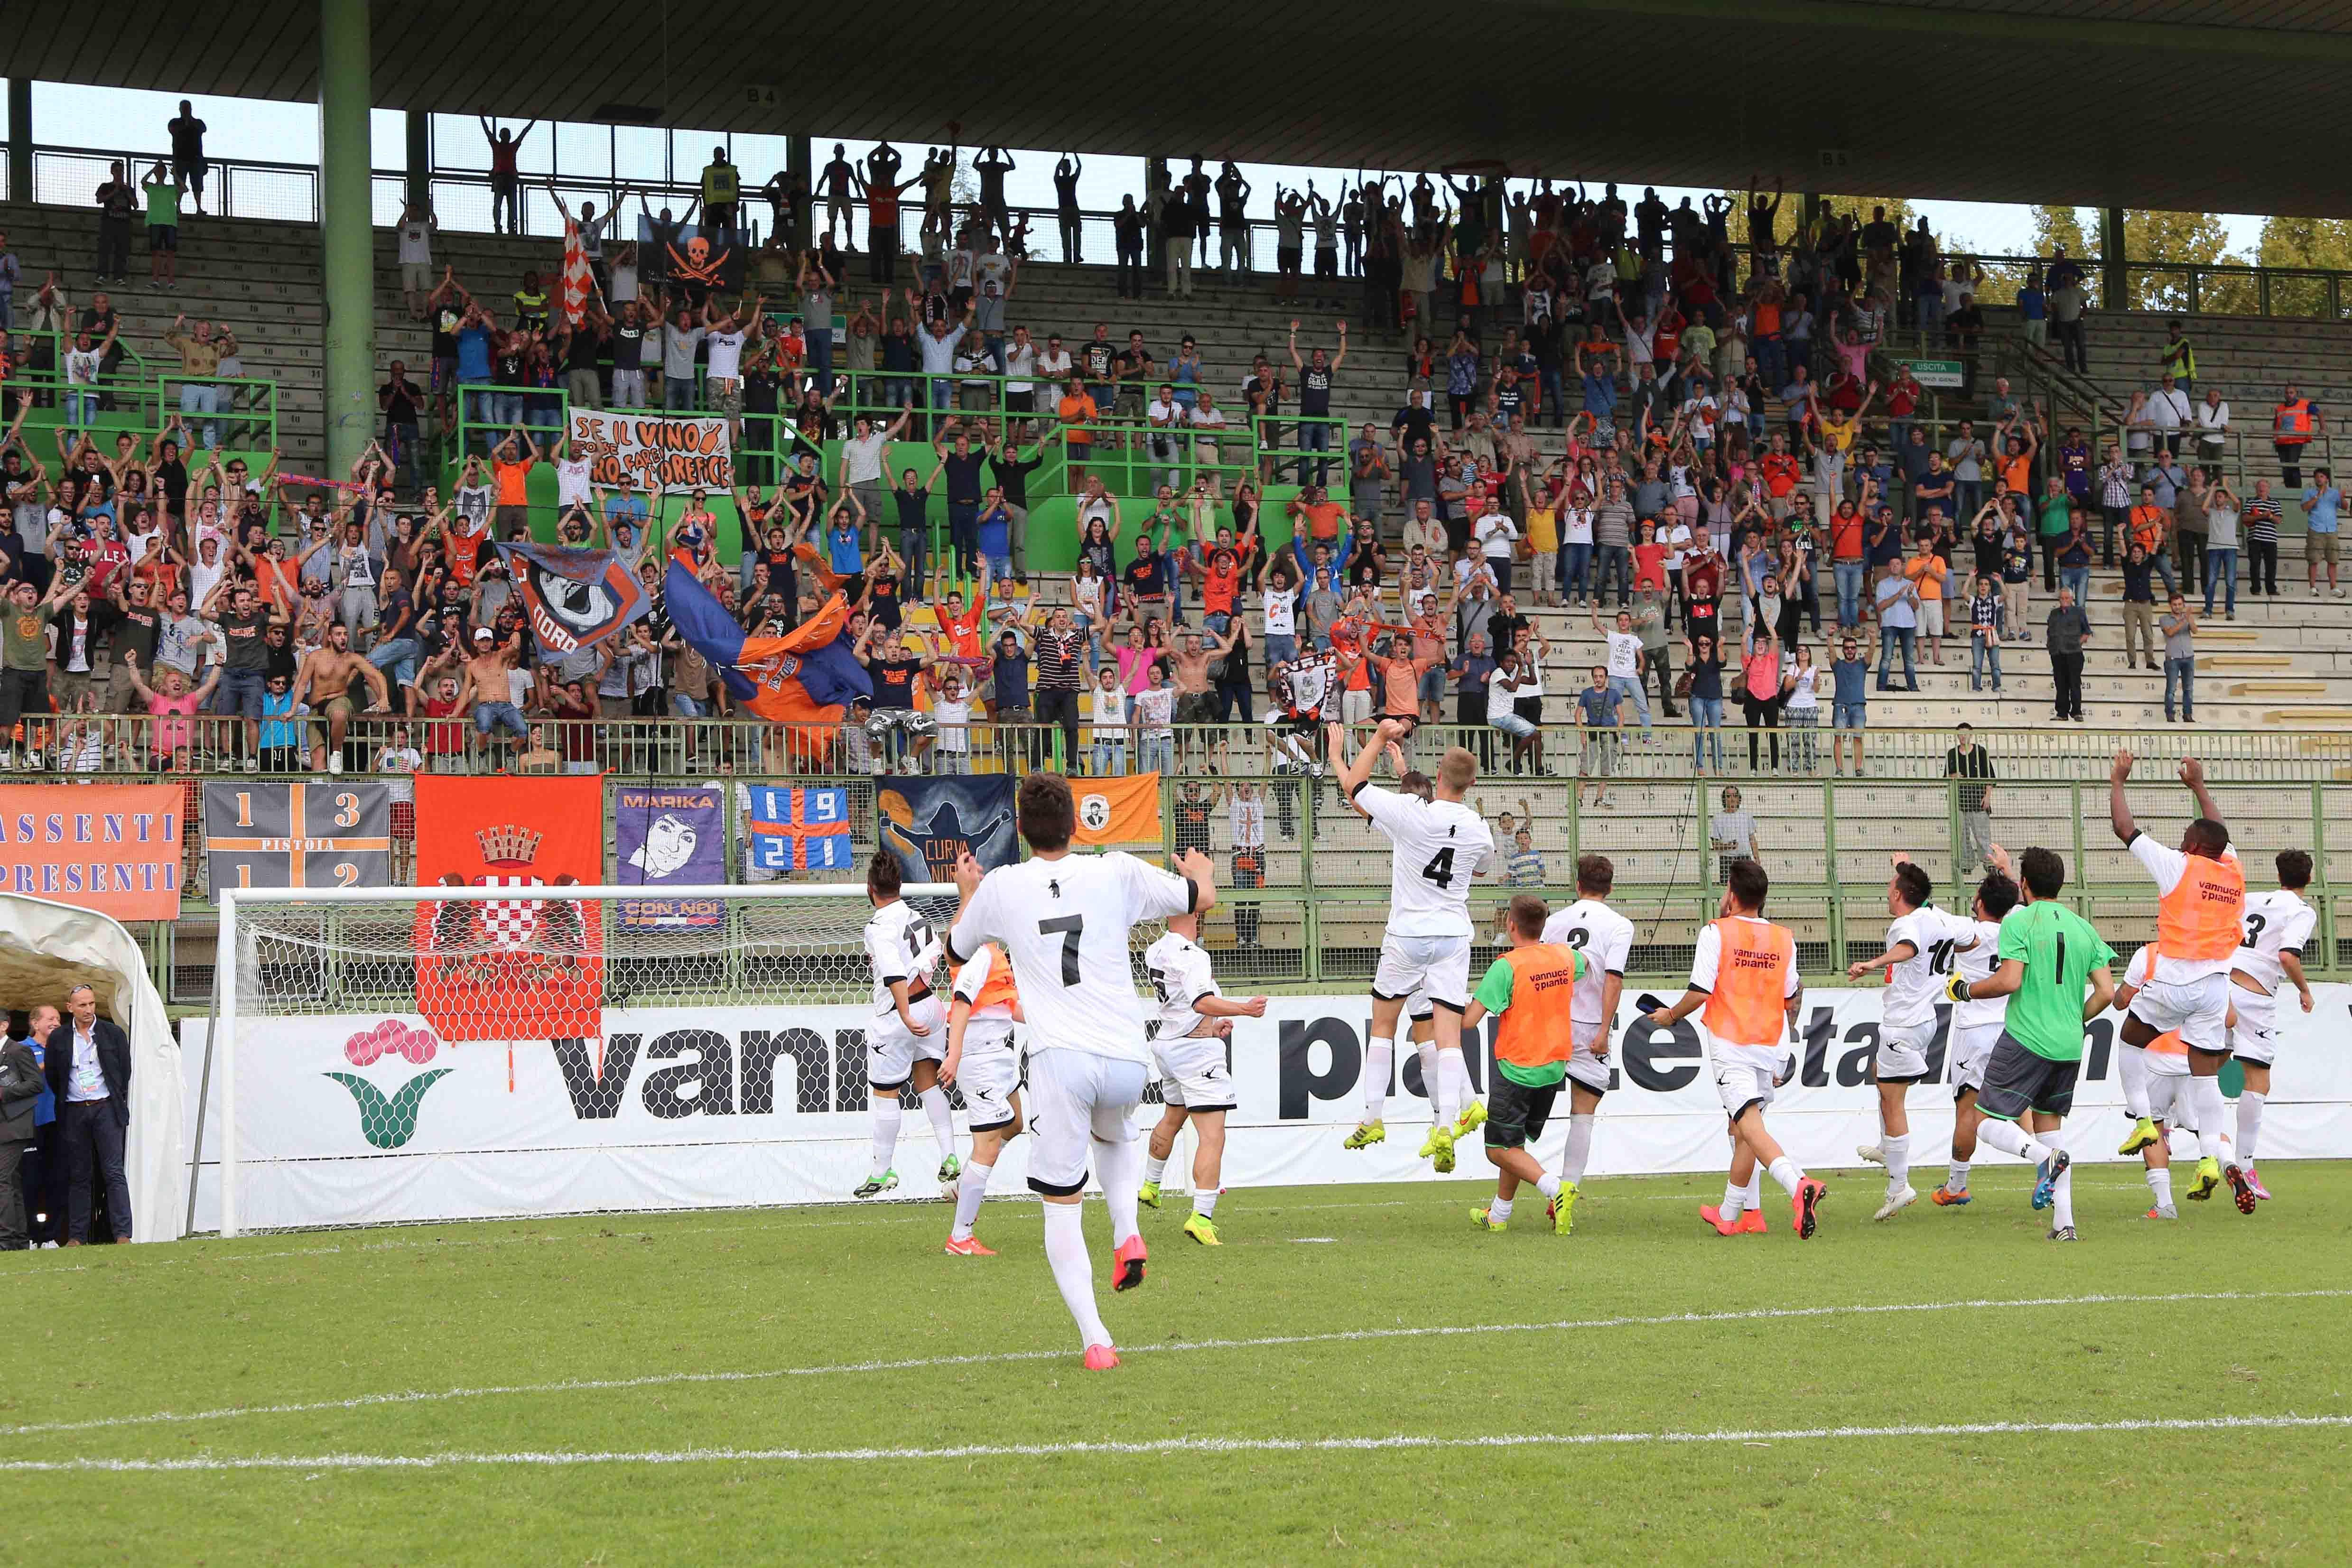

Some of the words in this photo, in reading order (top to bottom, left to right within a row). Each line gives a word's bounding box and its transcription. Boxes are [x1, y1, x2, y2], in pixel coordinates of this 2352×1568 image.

[1917, 363, 1947, 372] USCITA
[576, 417, 604, 441] SE
[613, 420, 632, 445] IL
[635, 421, 700, 452] VINO
[533, 603, 579, 654] NORD
[236, 792, 254, 827] 1
[334, 792, 361, 827] 3
[623, 794, 715, 808] MARIKA
[766, 791, 777, 820] 1
[817, 792, 837, 821] 9
[261, 838, 335, 851] PISTOIA
[764, 837, 785, 866] 2
[823, 838, 834, 866] 1
[926, 840, 971, 860] CURVA
[931, 864, 959, 883] NOR
[1422, 847, 1455, 890] 4
[2199, 881, 2242, 897] vannucci
[2208, 892, 2237, 905] piante
[625, 902, 672, 915] CON
[680, 902, 717, 915] NOI
[2239, 913, 2266, 948] 3
[1038, 913, 1084, 987] 7
[1733, 948, 1780, 961] vannucci
[1927, 938, 1955, 976] 10
[2056, 931, 2065, 984] 1
[1741, 958, 1776, 969] piante
[1529, 967, 1569, 982] vannucc
[1541, 977, 1569, 991] piante
[2020, 1141, 2031, 1158] GEA
